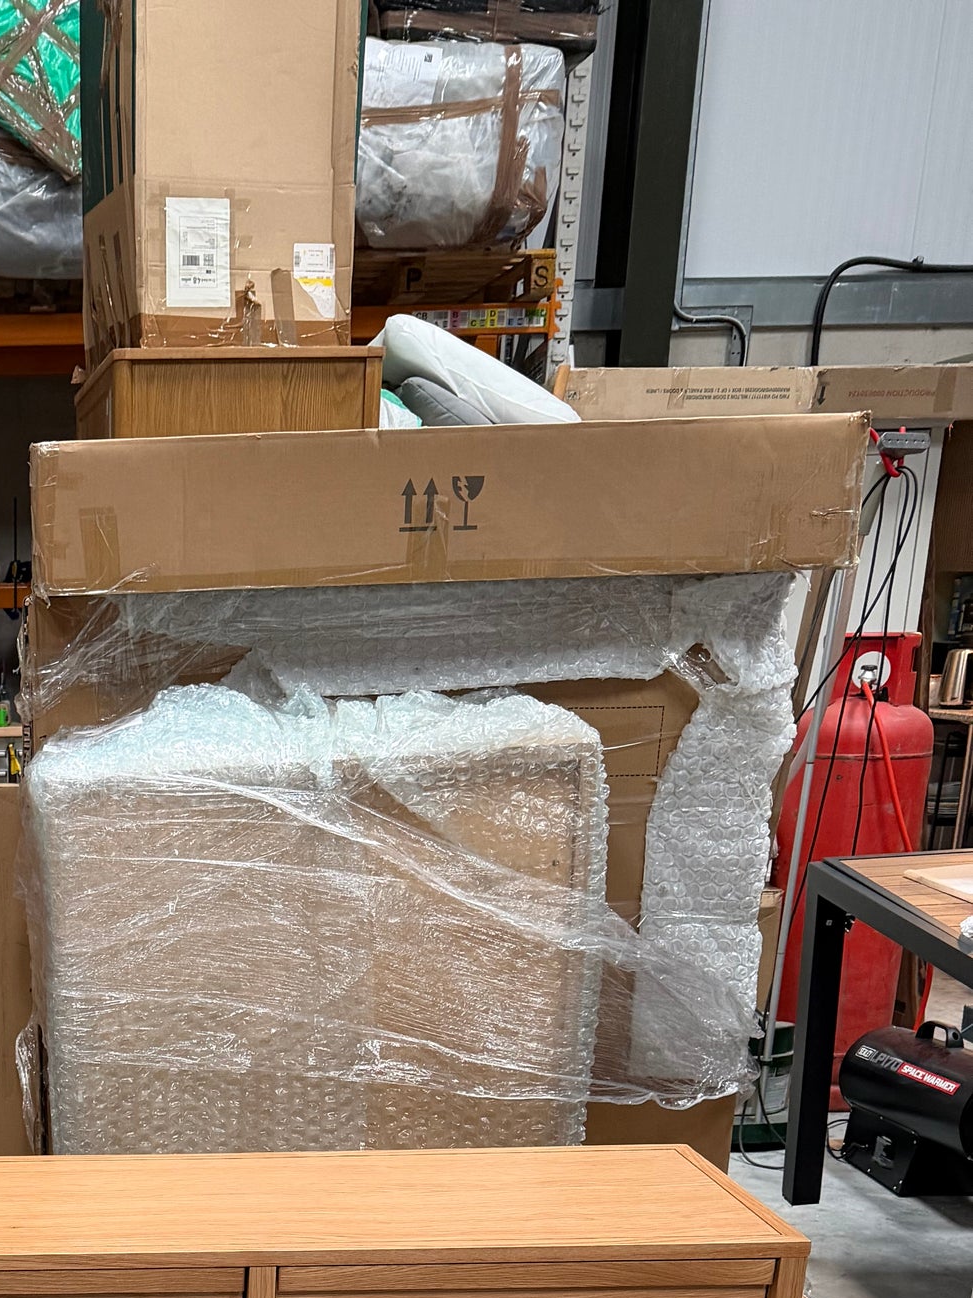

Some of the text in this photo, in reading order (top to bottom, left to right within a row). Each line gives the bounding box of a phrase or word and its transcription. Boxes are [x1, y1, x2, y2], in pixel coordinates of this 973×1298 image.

[406, 267, 422, 291] P
[534, 265, 549, 287] S
[901, 1065, 926, 1080] SPACE
[923, 1073, 956, 1092] WARMER
